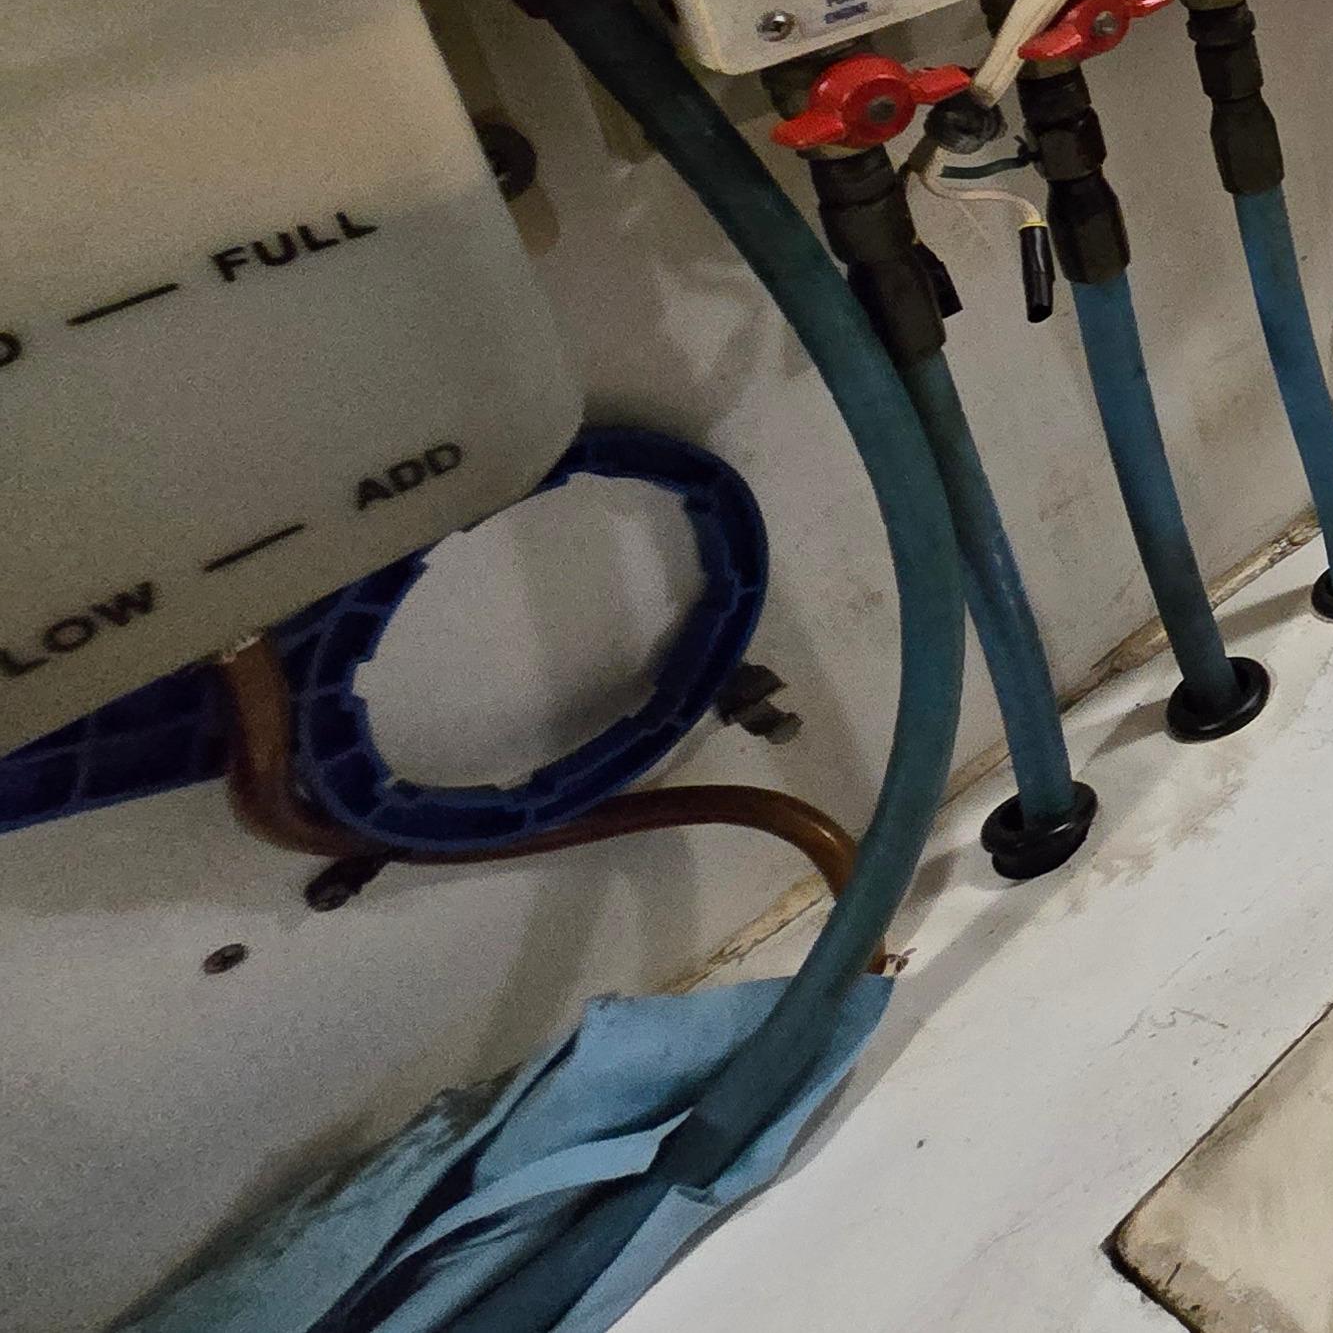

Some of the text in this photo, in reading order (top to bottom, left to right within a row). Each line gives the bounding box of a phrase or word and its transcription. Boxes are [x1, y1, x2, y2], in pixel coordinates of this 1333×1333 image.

[211, 210, 379, 283] FULL
[357, 442, 463, 512] ADD
[0, 580, 155, 678] LOW
